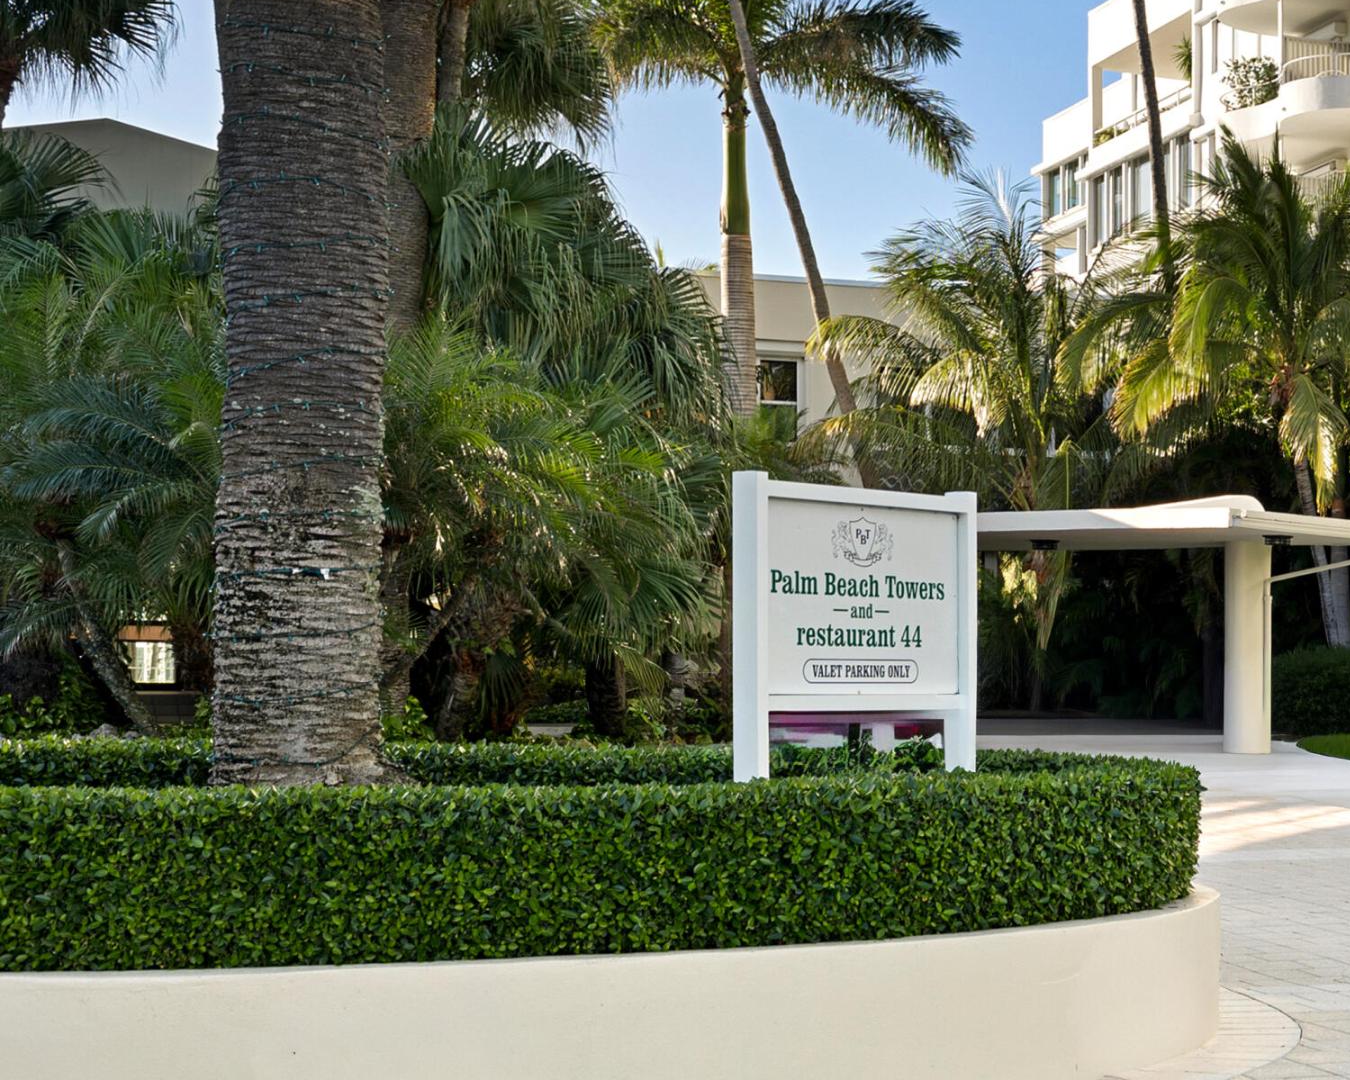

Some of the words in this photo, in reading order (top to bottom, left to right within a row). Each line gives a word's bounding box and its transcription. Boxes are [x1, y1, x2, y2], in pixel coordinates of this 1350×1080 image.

[770, 569, 818, 595] Palm
[824, 572, 880, 597] Beach
[885, 575, 945, 600] Towers
[850, 603, 873, 619] and
[796, 624, 896, 648] restaurant
[900, 625, 922, 648] 44
[812, 664, 842, 678] VALET
[845, 664, 886, 678] PARKING
[888, 665, 911, 678] ONLY
